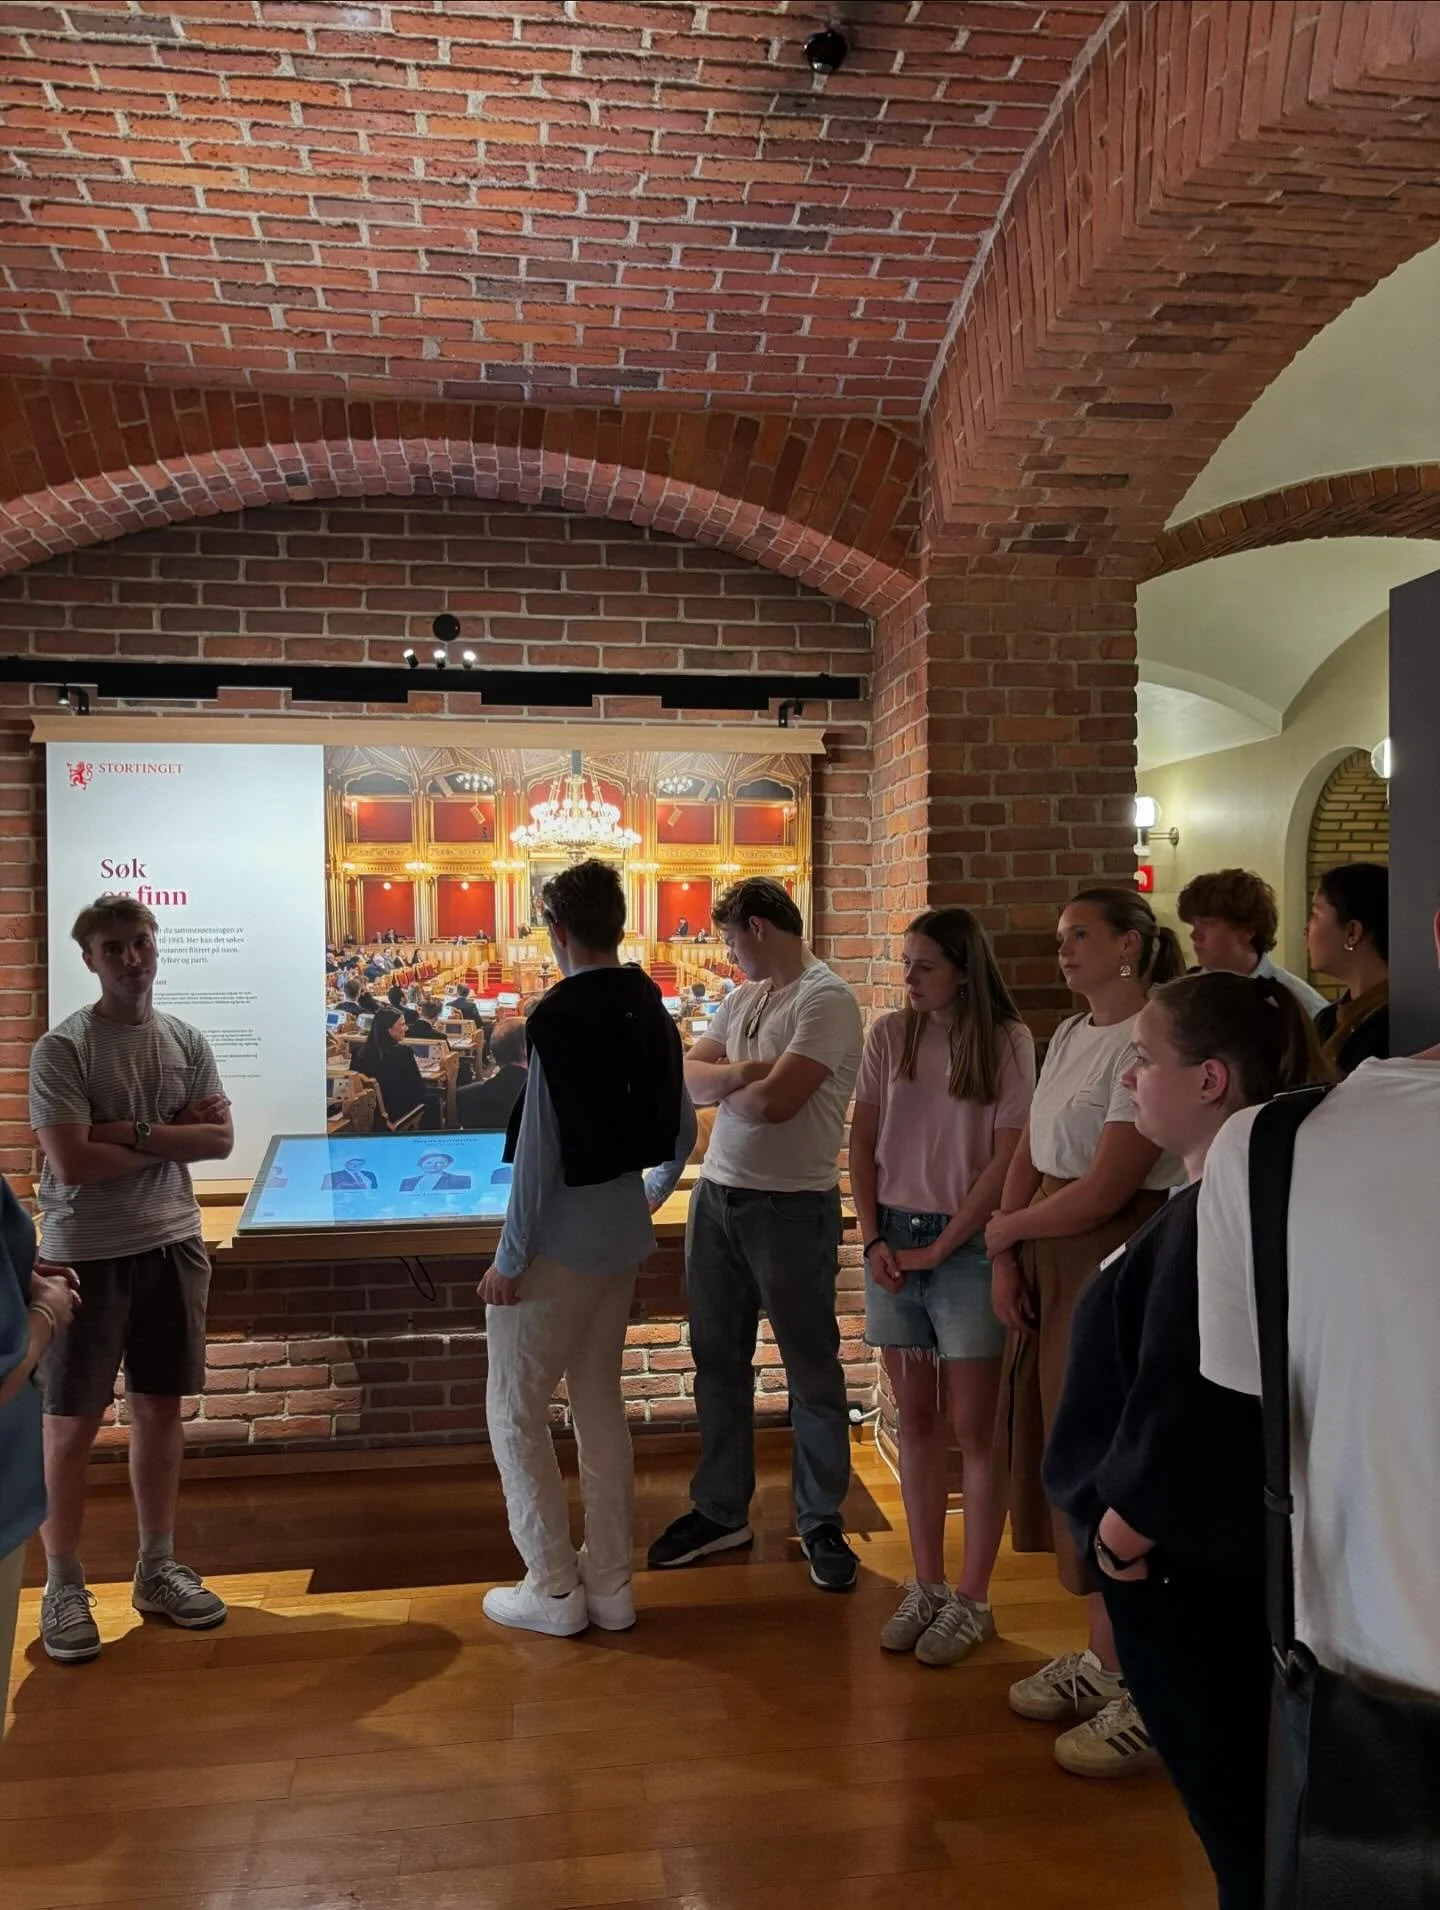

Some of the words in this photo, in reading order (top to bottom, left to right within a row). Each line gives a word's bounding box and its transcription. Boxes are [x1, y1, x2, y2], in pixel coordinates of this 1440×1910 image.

[98, 763, 183, 774] STORTINGET
[100, 858, 147, 878] Søk
[137, 885, 187, 905] finn
[211, 946, 219, 954] på
